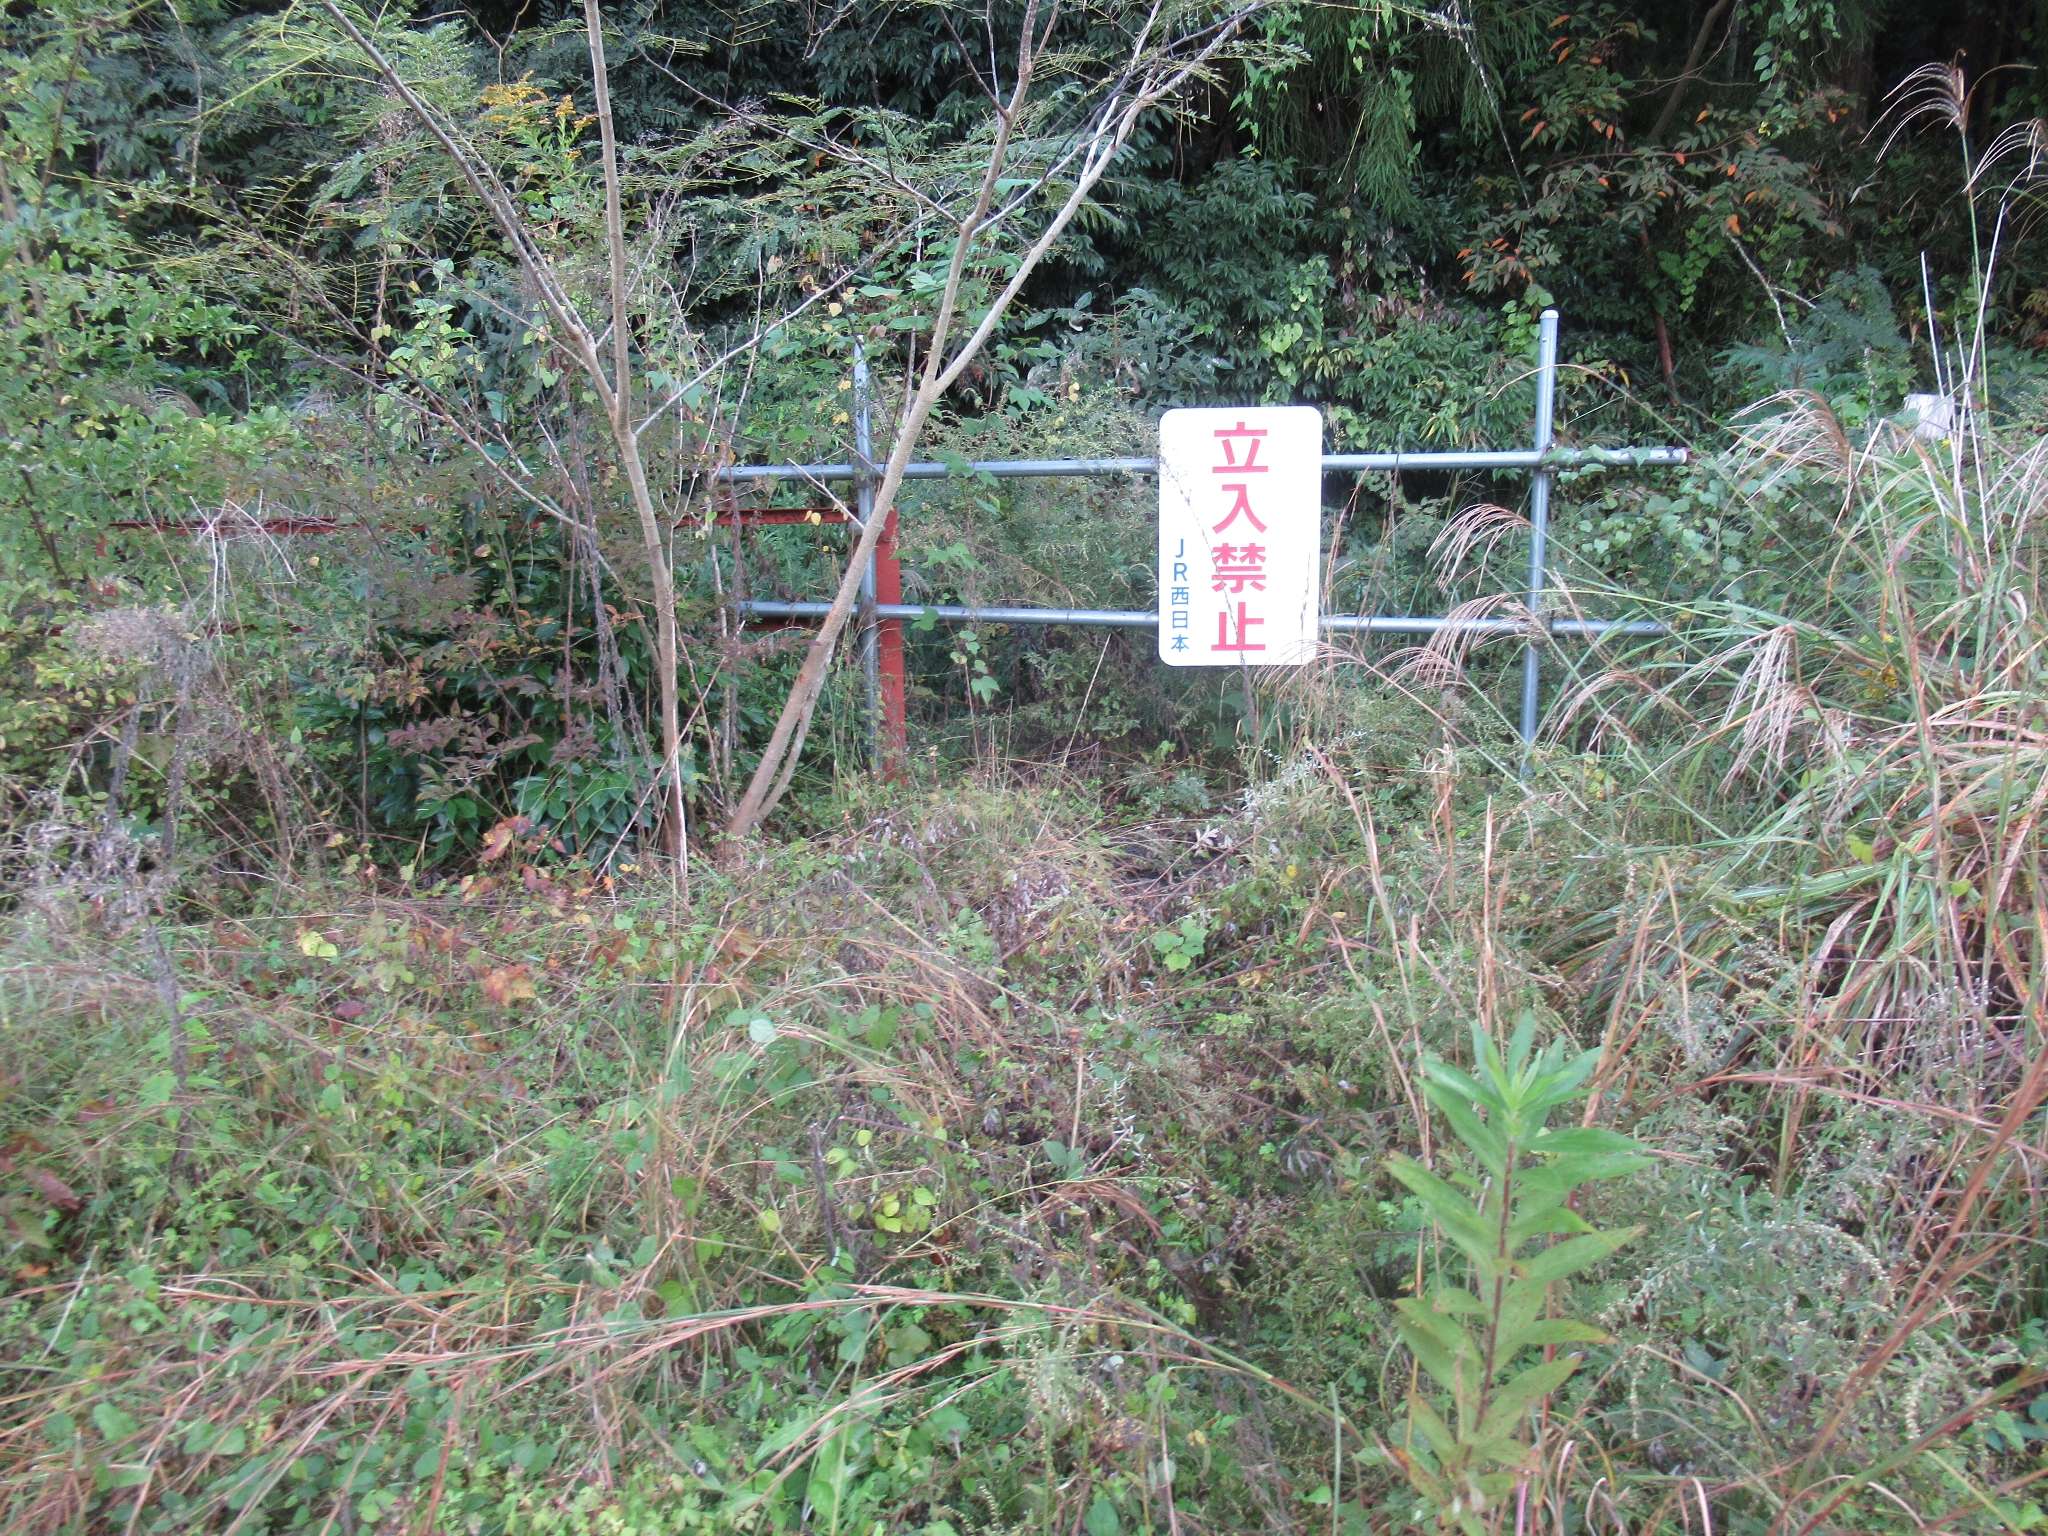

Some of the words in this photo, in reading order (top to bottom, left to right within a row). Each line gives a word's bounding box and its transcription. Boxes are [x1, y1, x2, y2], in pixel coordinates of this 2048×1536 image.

[1171, 538, 1190, 652] JR西日本
[1211, 421, 1269, 651] 立入禁止
